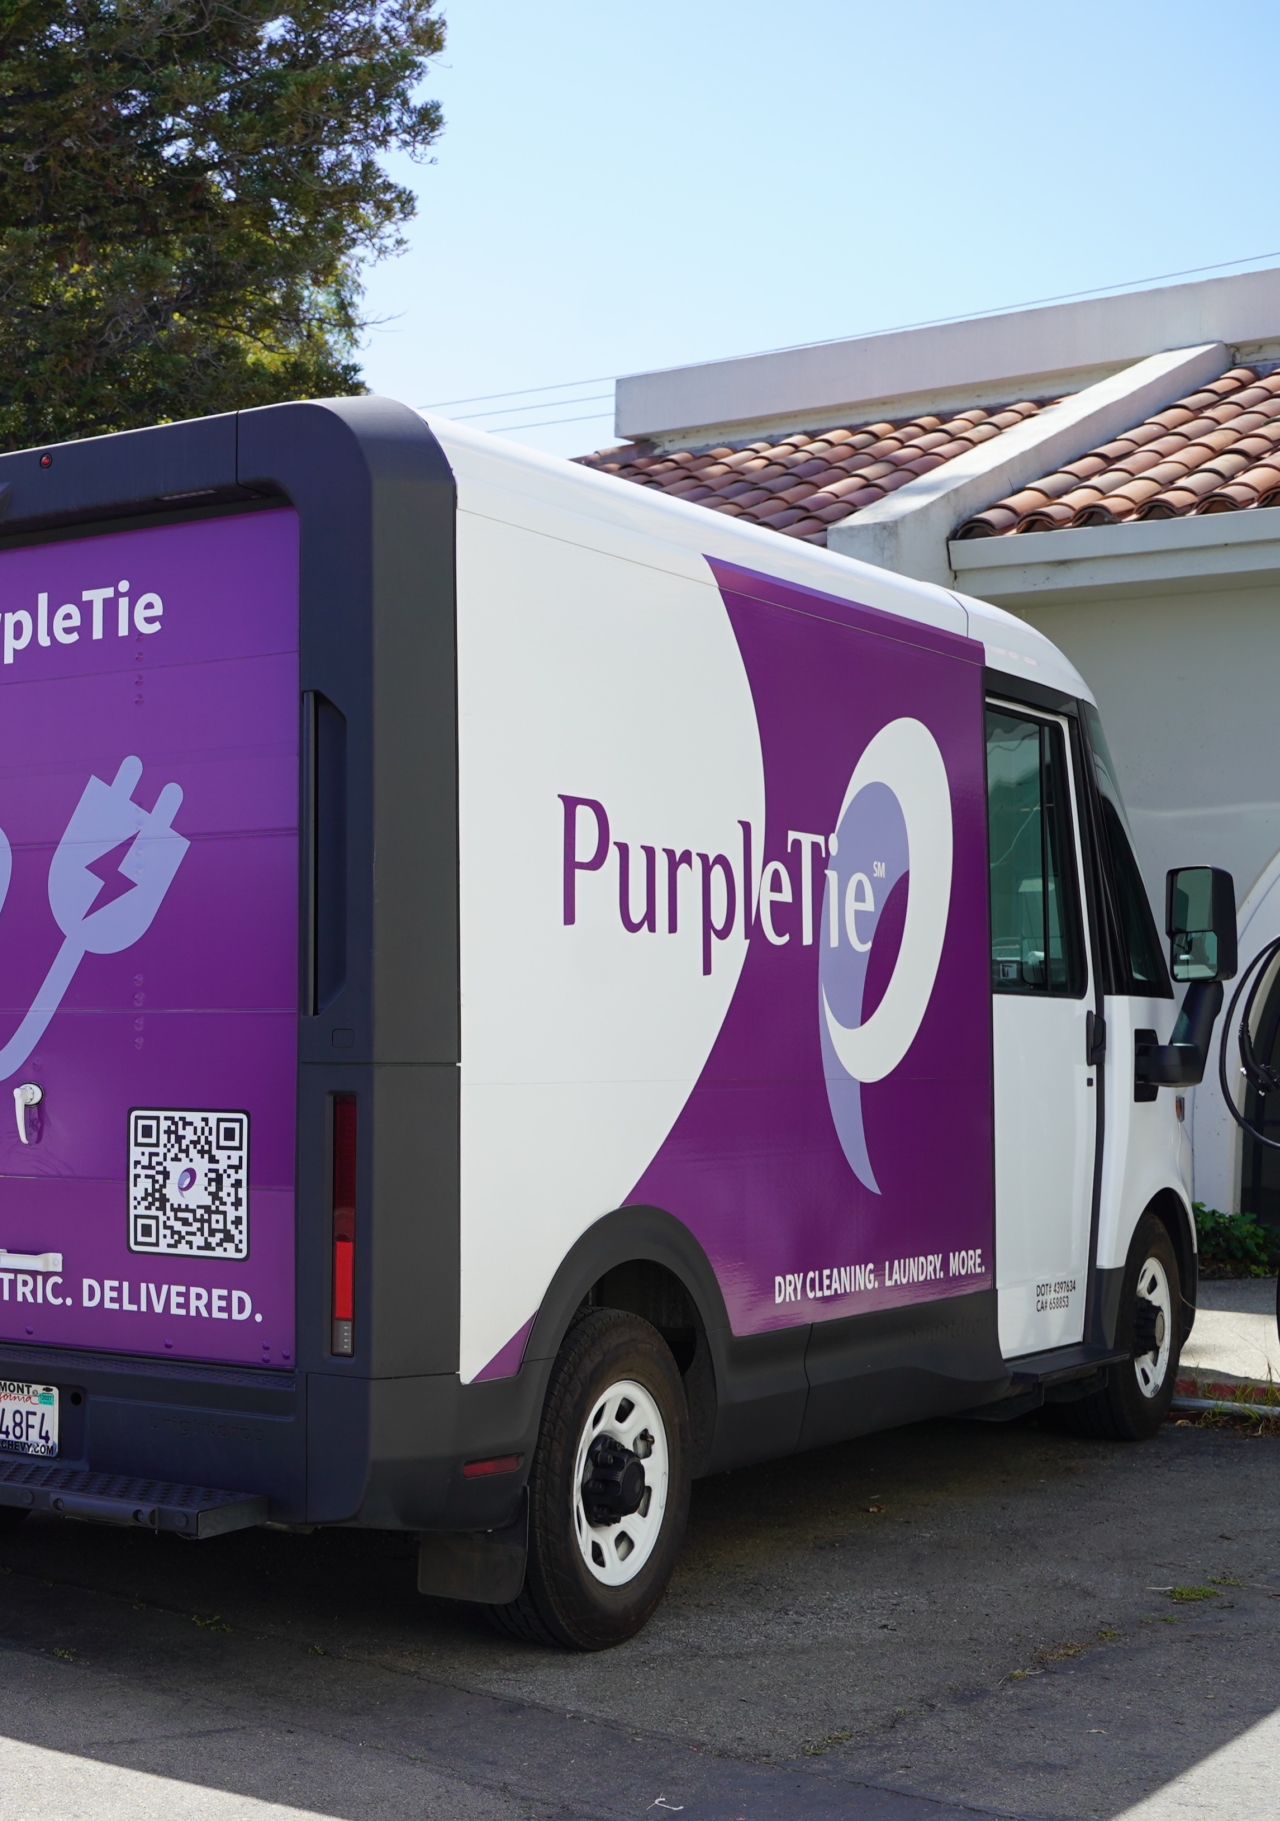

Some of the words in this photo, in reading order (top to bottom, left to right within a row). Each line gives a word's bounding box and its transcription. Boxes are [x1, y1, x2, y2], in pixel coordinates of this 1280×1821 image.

[557, 793, 876, 977] PurpleTie
[82, 1278, 263, 1323] DELIVERED.
[774, 1272, 804, 1304] DRY
[806, 1262, 879, 1299] CLEANING.
[884, 1253, 944, 1287] LAUNDRY.
[949, 1248, 985, 1278] MORE.
[1036, 1282, 1052, 1297] DOT#
